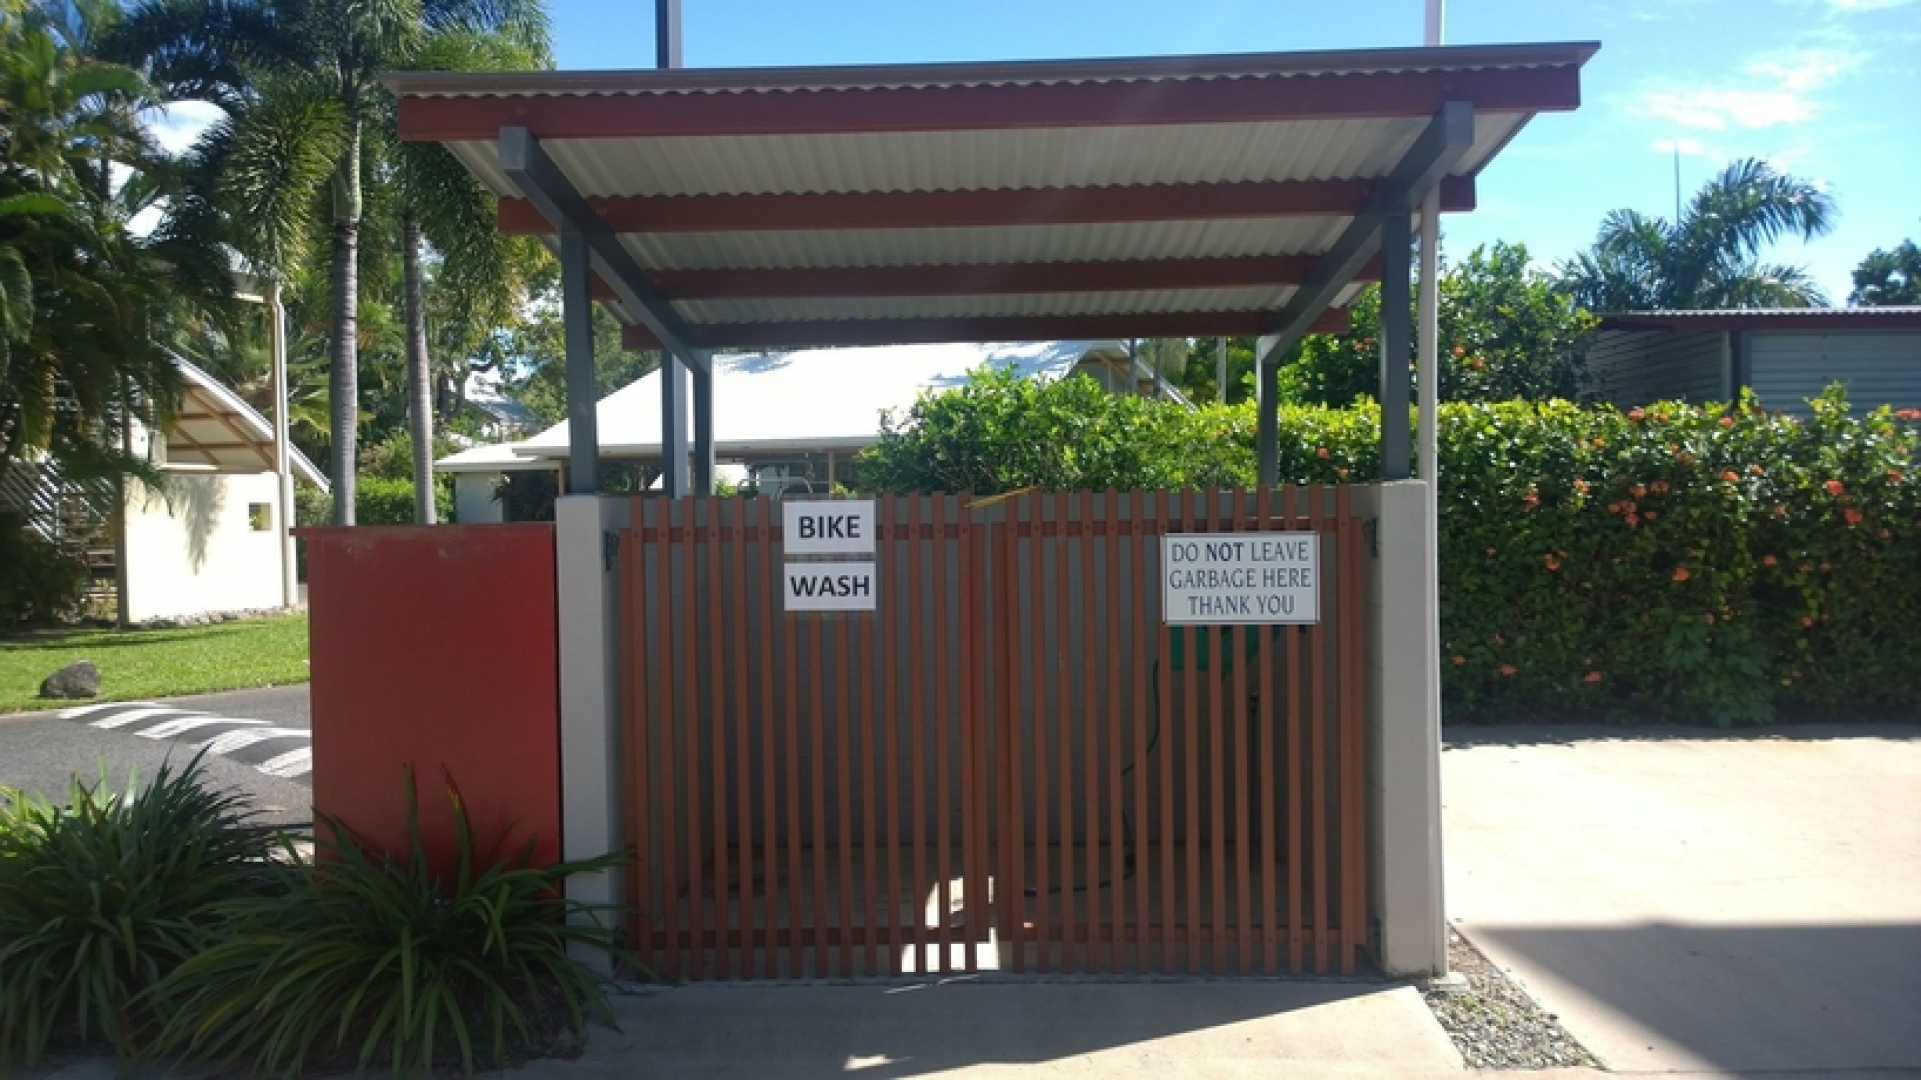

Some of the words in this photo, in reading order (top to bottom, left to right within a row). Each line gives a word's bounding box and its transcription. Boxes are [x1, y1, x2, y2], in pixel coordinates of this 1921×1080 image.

[798, 515, 861, 539] BIKE
[1171, 542, 1199, 562] DO
[1206, 541, 1245, 562] NOT
[1250, 541, 1309, 562] LEAVE
[789, 574, 870, 598] WASH
[1169, 568, 1257, 589] GARBAGE
[1262, 568, 1312, 588] HERE
[1187, 594, 1251, 615] THANK
[1255, 594, 1296, 615] YOU
